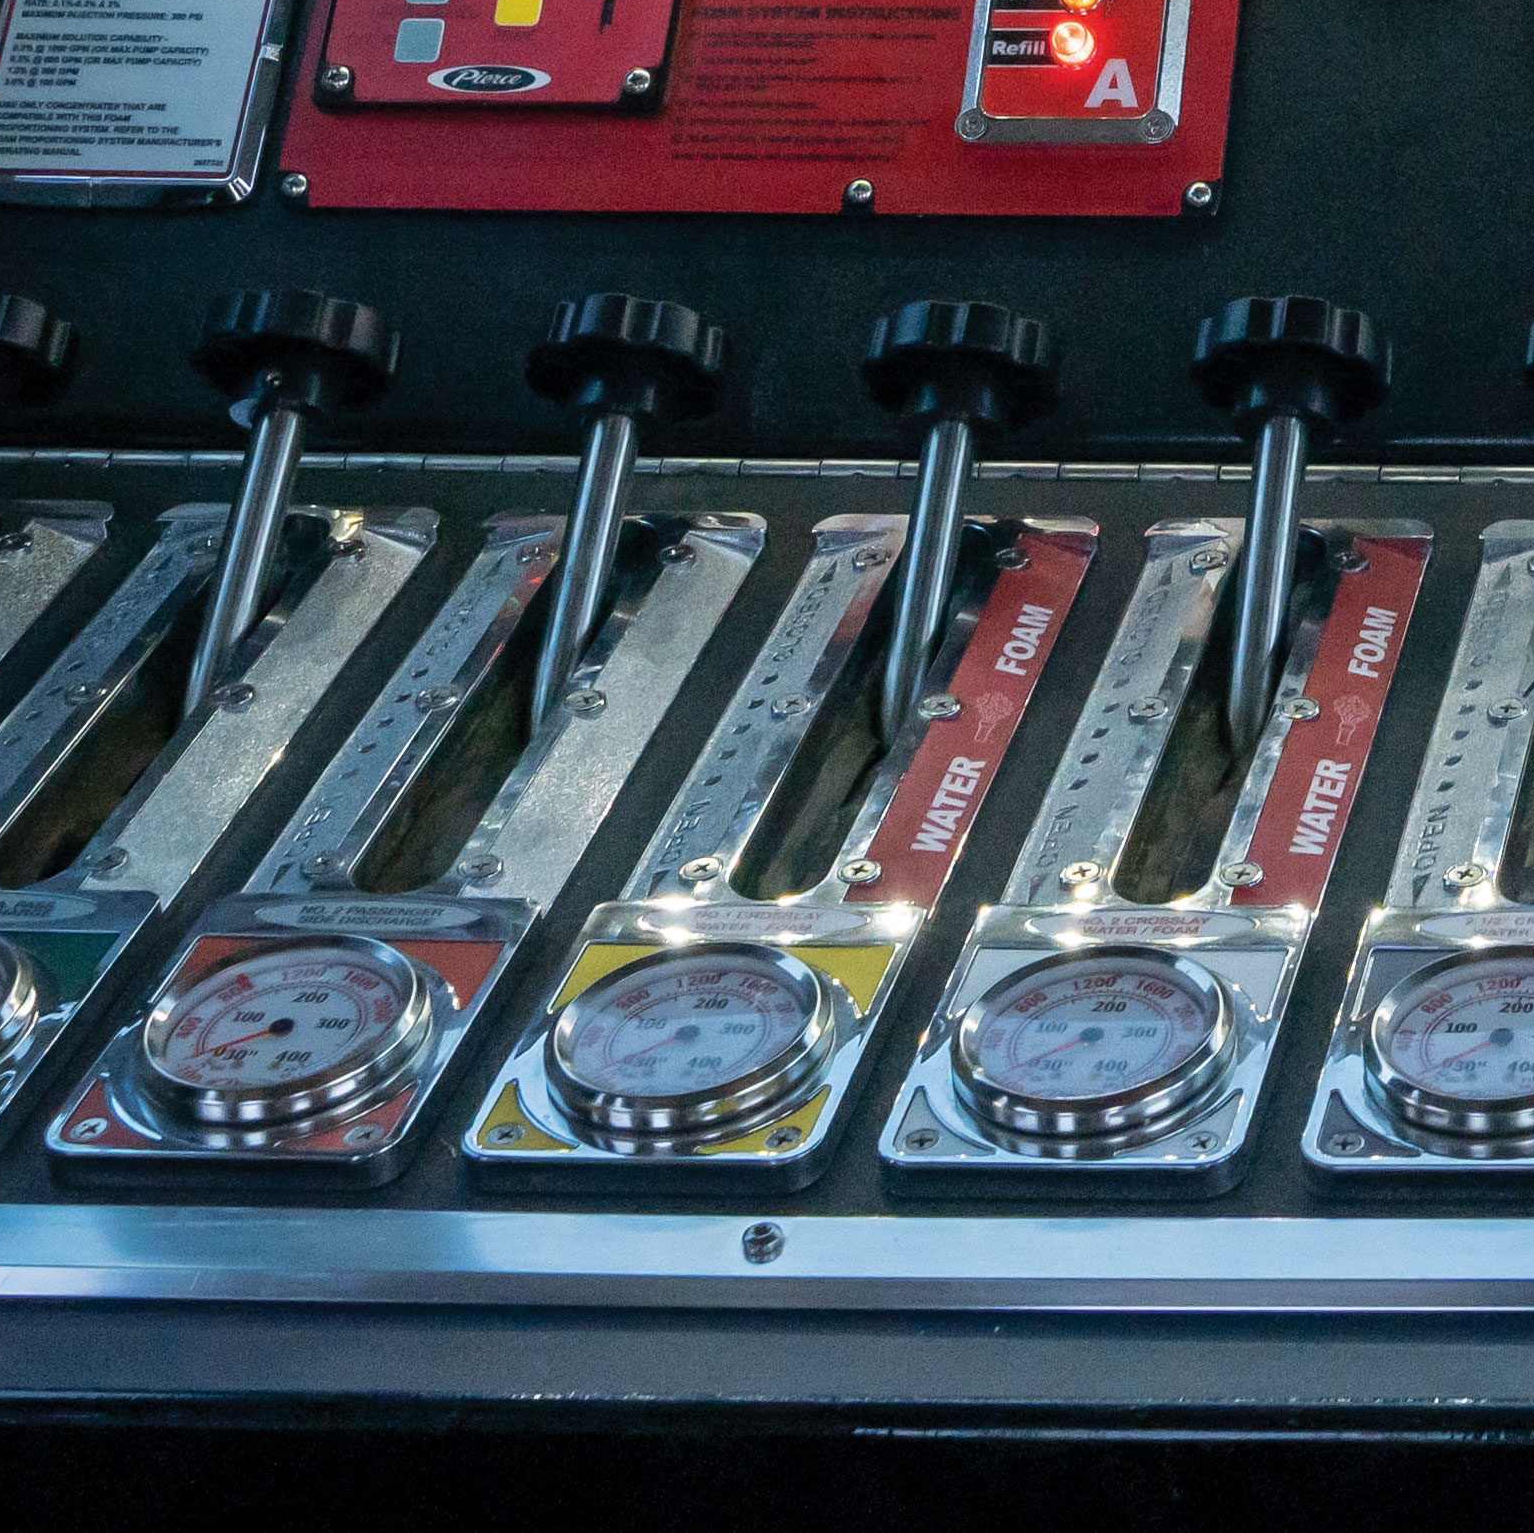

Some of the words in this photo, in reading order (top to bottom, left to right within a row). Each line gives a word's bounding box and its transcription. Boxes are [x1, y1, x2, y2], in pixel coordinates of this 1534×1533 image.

[453, 68, 525, 87] Pierce
[992, 40, 1046, 55] Refill
[1083, 58, 1139, 108] A
[995, 603, 1053, 676] FOAM
[1347, 606, 1398, 678] FOAM
[910, 756, 986, 853] WATER
[1288, 759, 1352, 856] WATER
